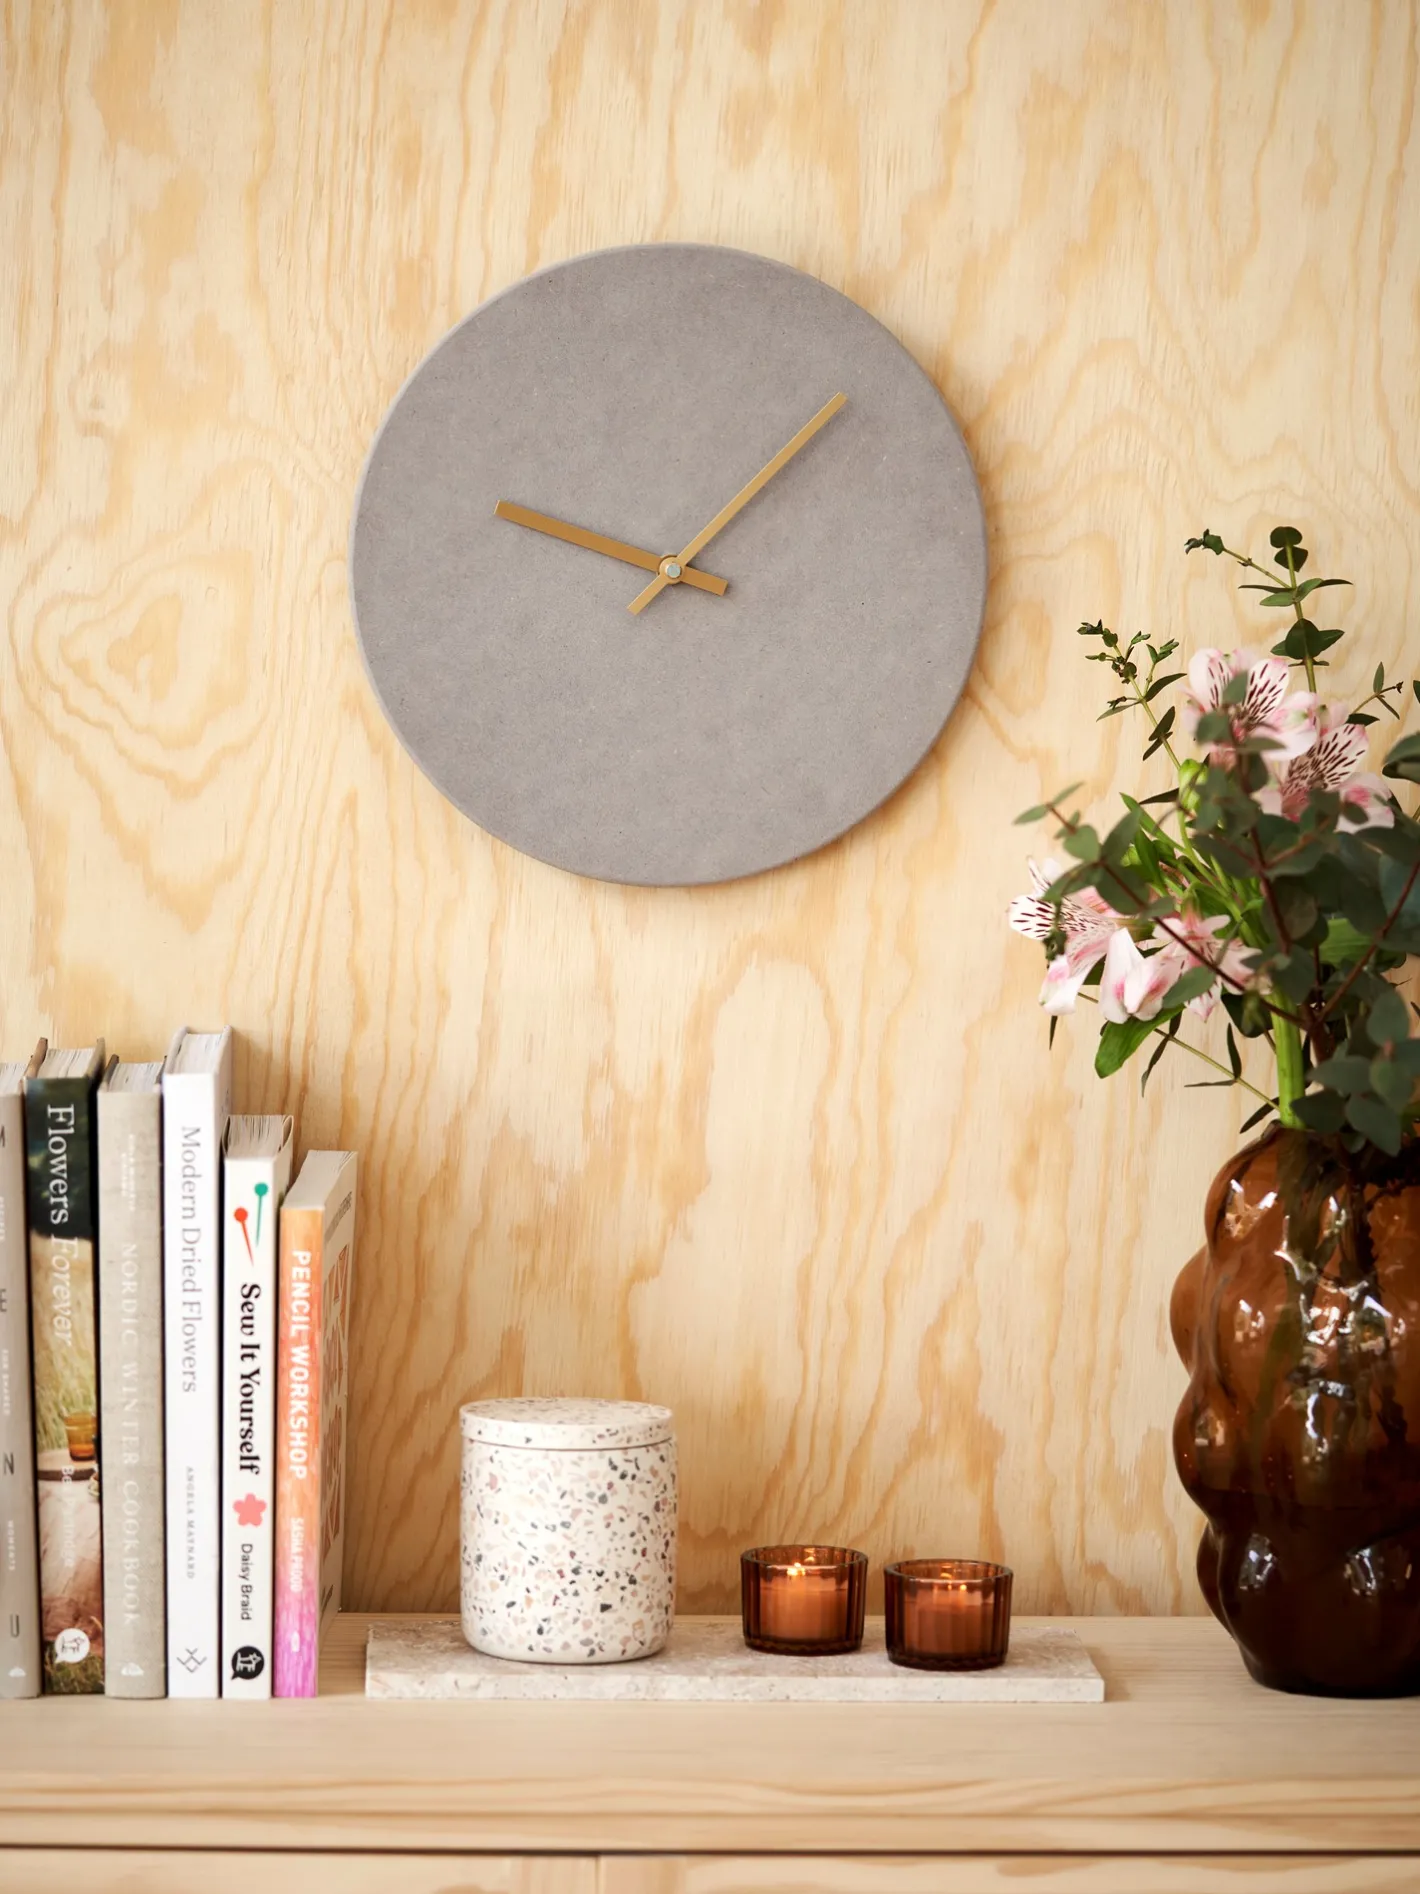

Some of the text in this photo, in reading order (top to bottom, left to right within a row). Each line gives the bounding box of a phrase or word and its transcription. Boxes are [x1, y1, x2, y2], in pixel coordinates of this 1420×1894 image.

[47, 1103, 79, 1347] Flowers Forever
[181, 1126, 202, 1393] Modern Dried Flowers
[121, 1243, 140, 1625] NORDIC WINTER COOKBOOK
[239, 1283, 262, 1475] Sew It Yourself
[289, 1250, 312, 1479] PENCIL WORKSHOP
[186, 1466, 195, 1579] ANGELA MAYNARD
[238, 1543, 253, 1621] Daisy Braid
[290, 1517, 304, 1553] SASHA
